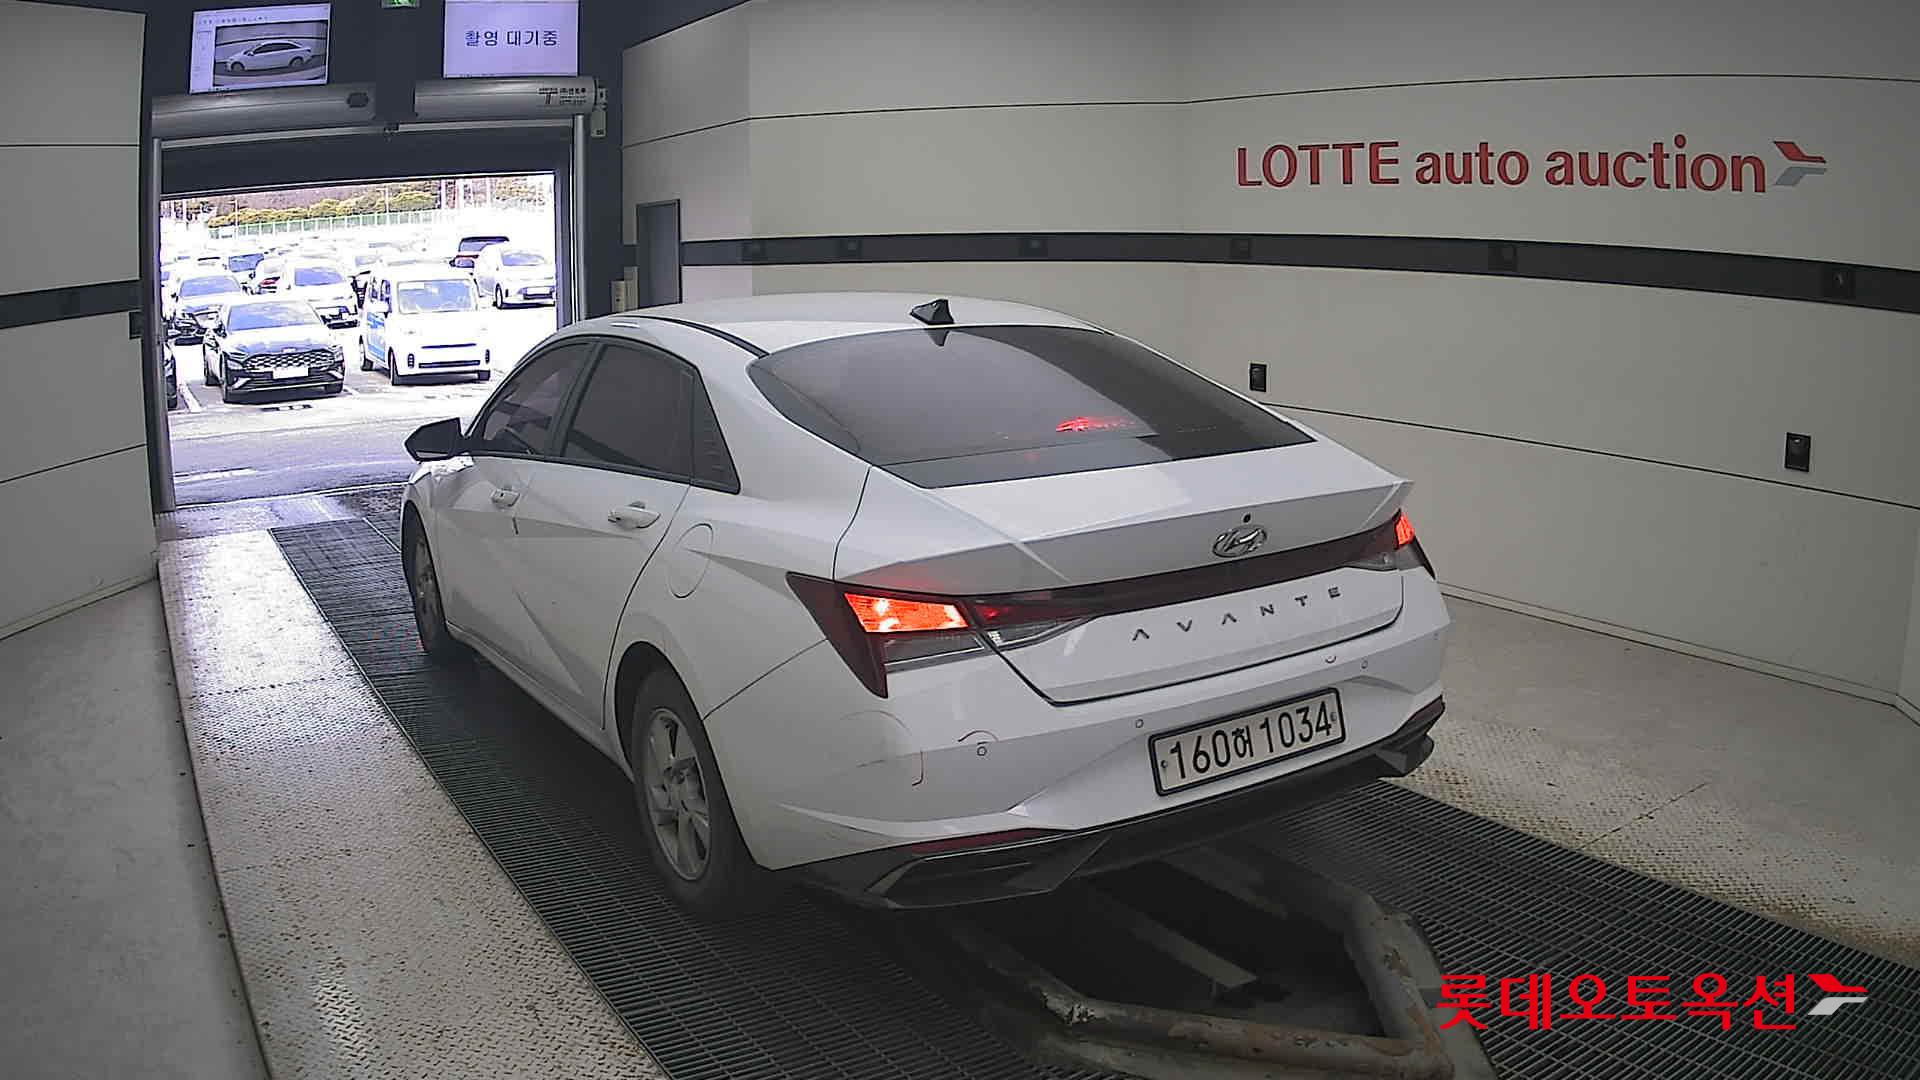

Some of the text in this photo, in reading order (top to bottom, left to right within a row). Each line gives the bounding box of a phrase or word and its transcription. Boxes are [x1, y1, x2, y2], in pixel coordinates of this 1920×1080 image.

[465, 30, 557, 47] 촬영 대기중
[1237, 134, 1766, 193] LOTTE auto auction
[1132, 586, 1341, 641] AVANTE
